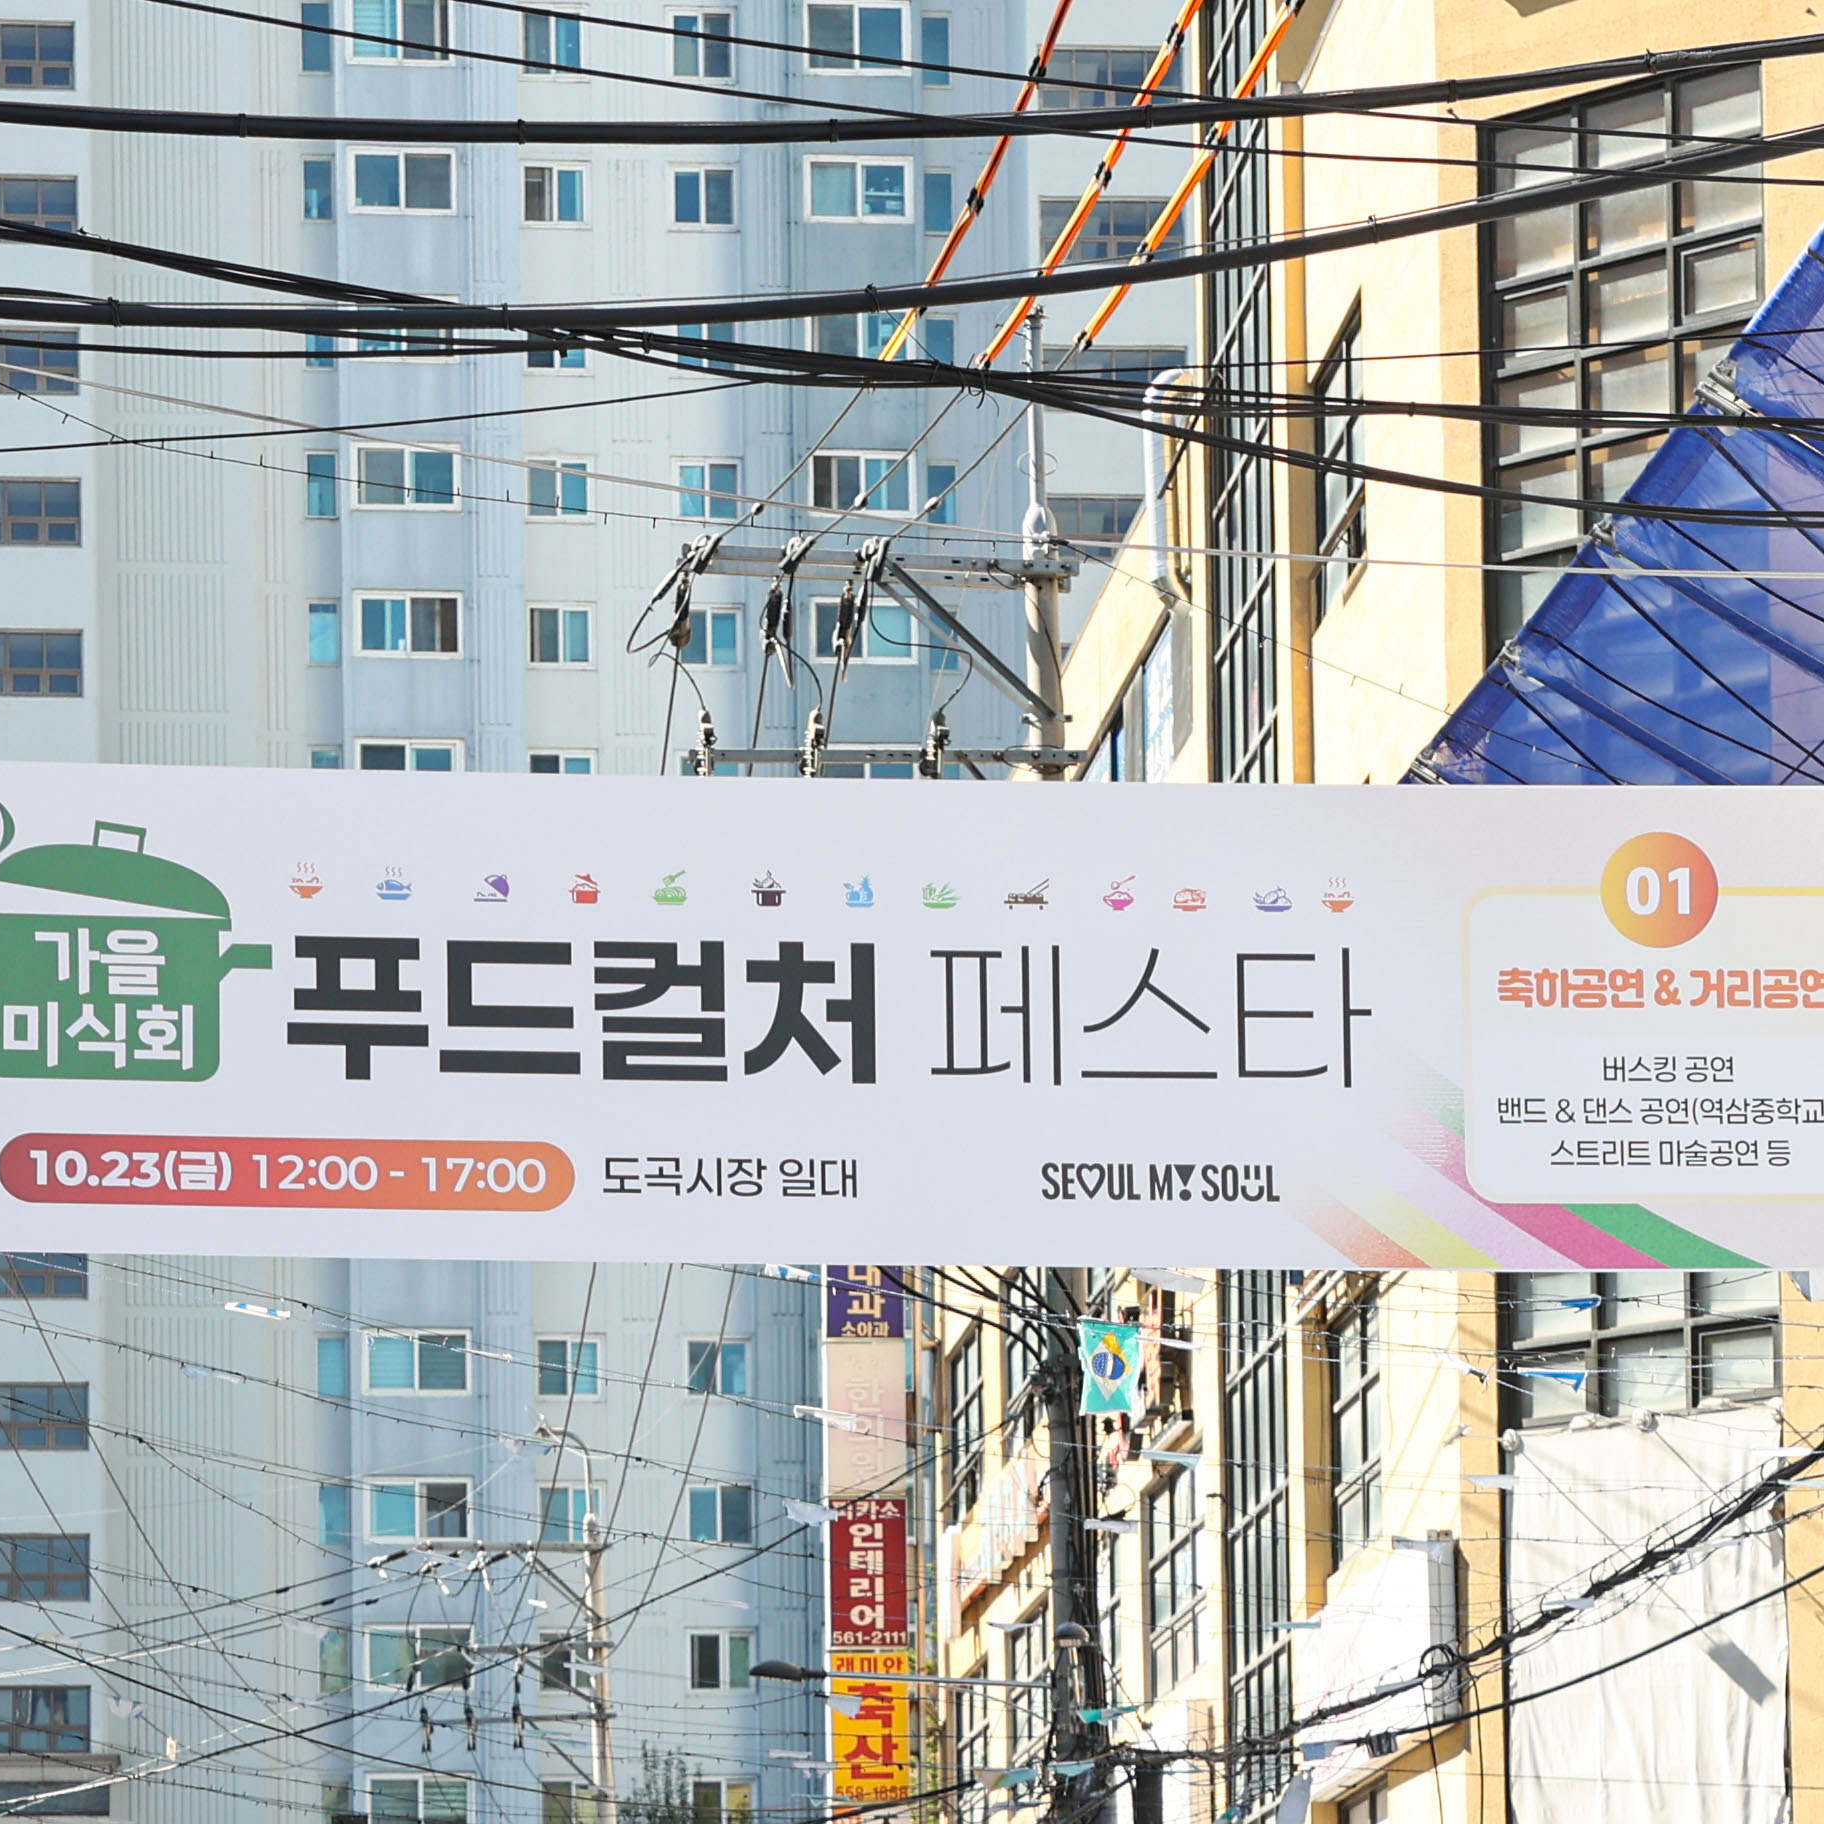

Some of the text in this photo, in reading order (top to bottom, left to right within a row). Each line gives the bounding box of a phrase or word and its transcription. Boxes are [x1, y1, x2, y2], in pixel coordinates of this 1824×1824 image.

[1624, 866, 1693, 916] 01
[34, 926, 166, 998] 가을
[1496, 967, 1645, 1010] 축하공연
[1653, 970, 1682, 1006] &
[286, 934, 1373, 1088] 푸드컬처 페스타
[2, 1000, 195, 1072] 미식회
[1601, 1055, 1736, 1084] 버스킹 공연
[1496, 1096, 1548, 1125] 밴드
[1554, 1100, 1577, 1124] &
[1582, 1097, 1633, 1125] 댄스
[28, 1148, 546, 1194] 10.23(금) 12:00 17:00
[1550, 1138, 1792, 1168] 스트리트 마술공연 등
[602, 1156, 860, 1199] 도곡시장 일대
[840, 1322, 890, 1338] 소아과
[848, 1523, 886, 1629] 인테리어
[832, 1630, 907, 1646] 561-2111
[836, 1655, 904, 1674] 래미안
[844, 1682, 899, 1780] 축산
